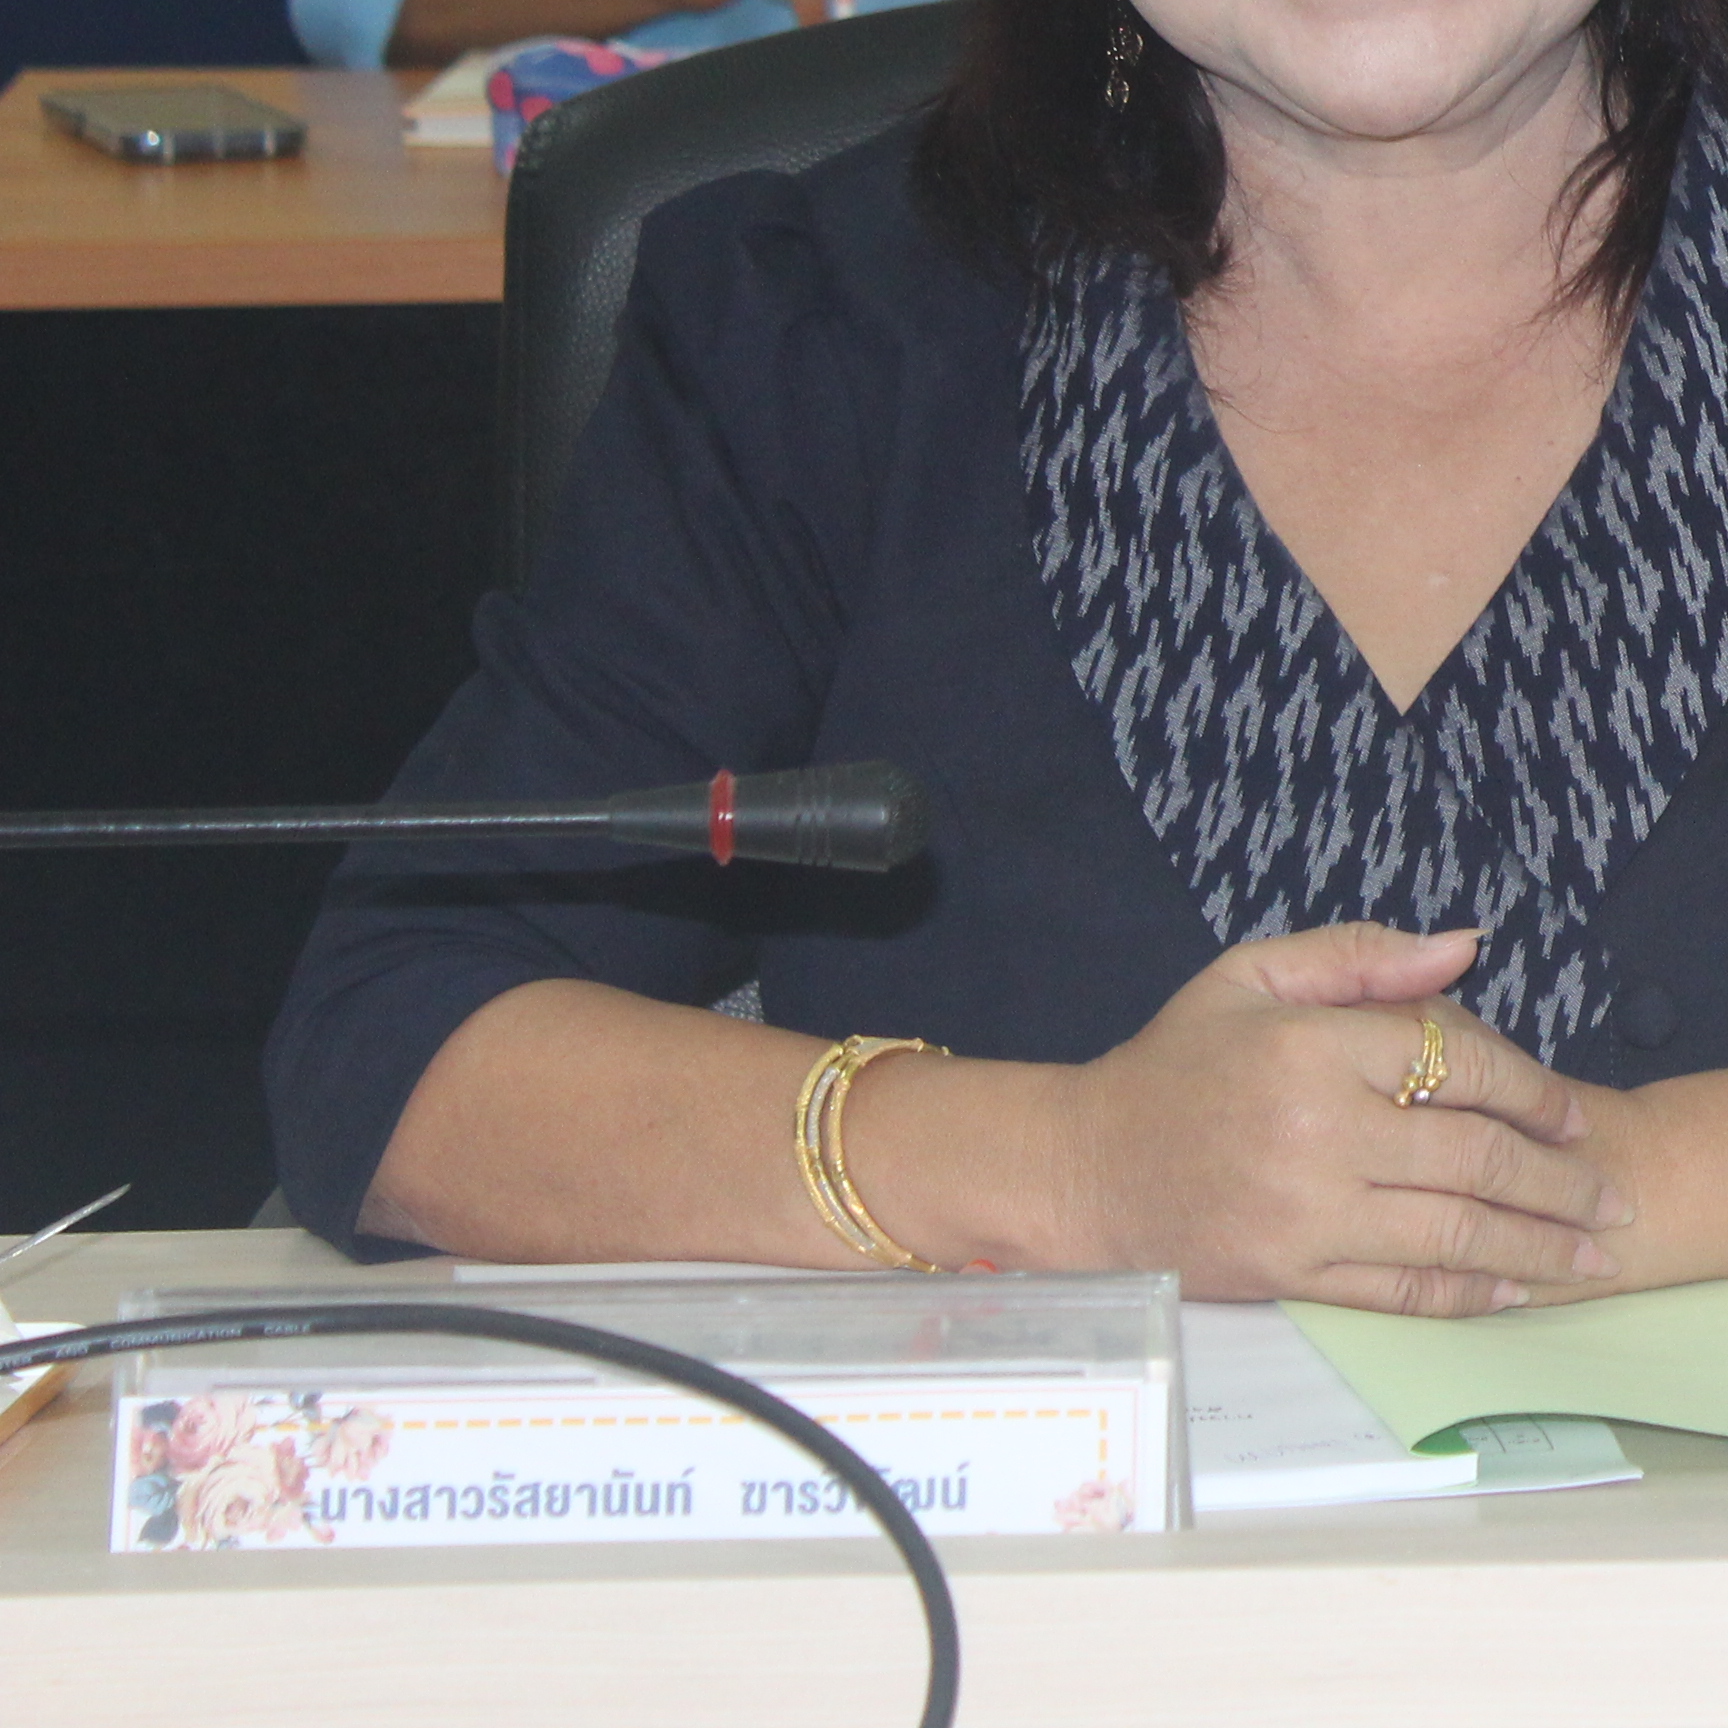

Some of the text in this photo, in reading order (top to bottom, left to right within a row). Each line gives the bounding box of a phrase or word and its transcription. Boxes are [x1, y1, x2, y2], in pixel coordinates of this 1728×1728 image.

[319, 1466, 696, 1522] นางสาวรัสยานันท์
